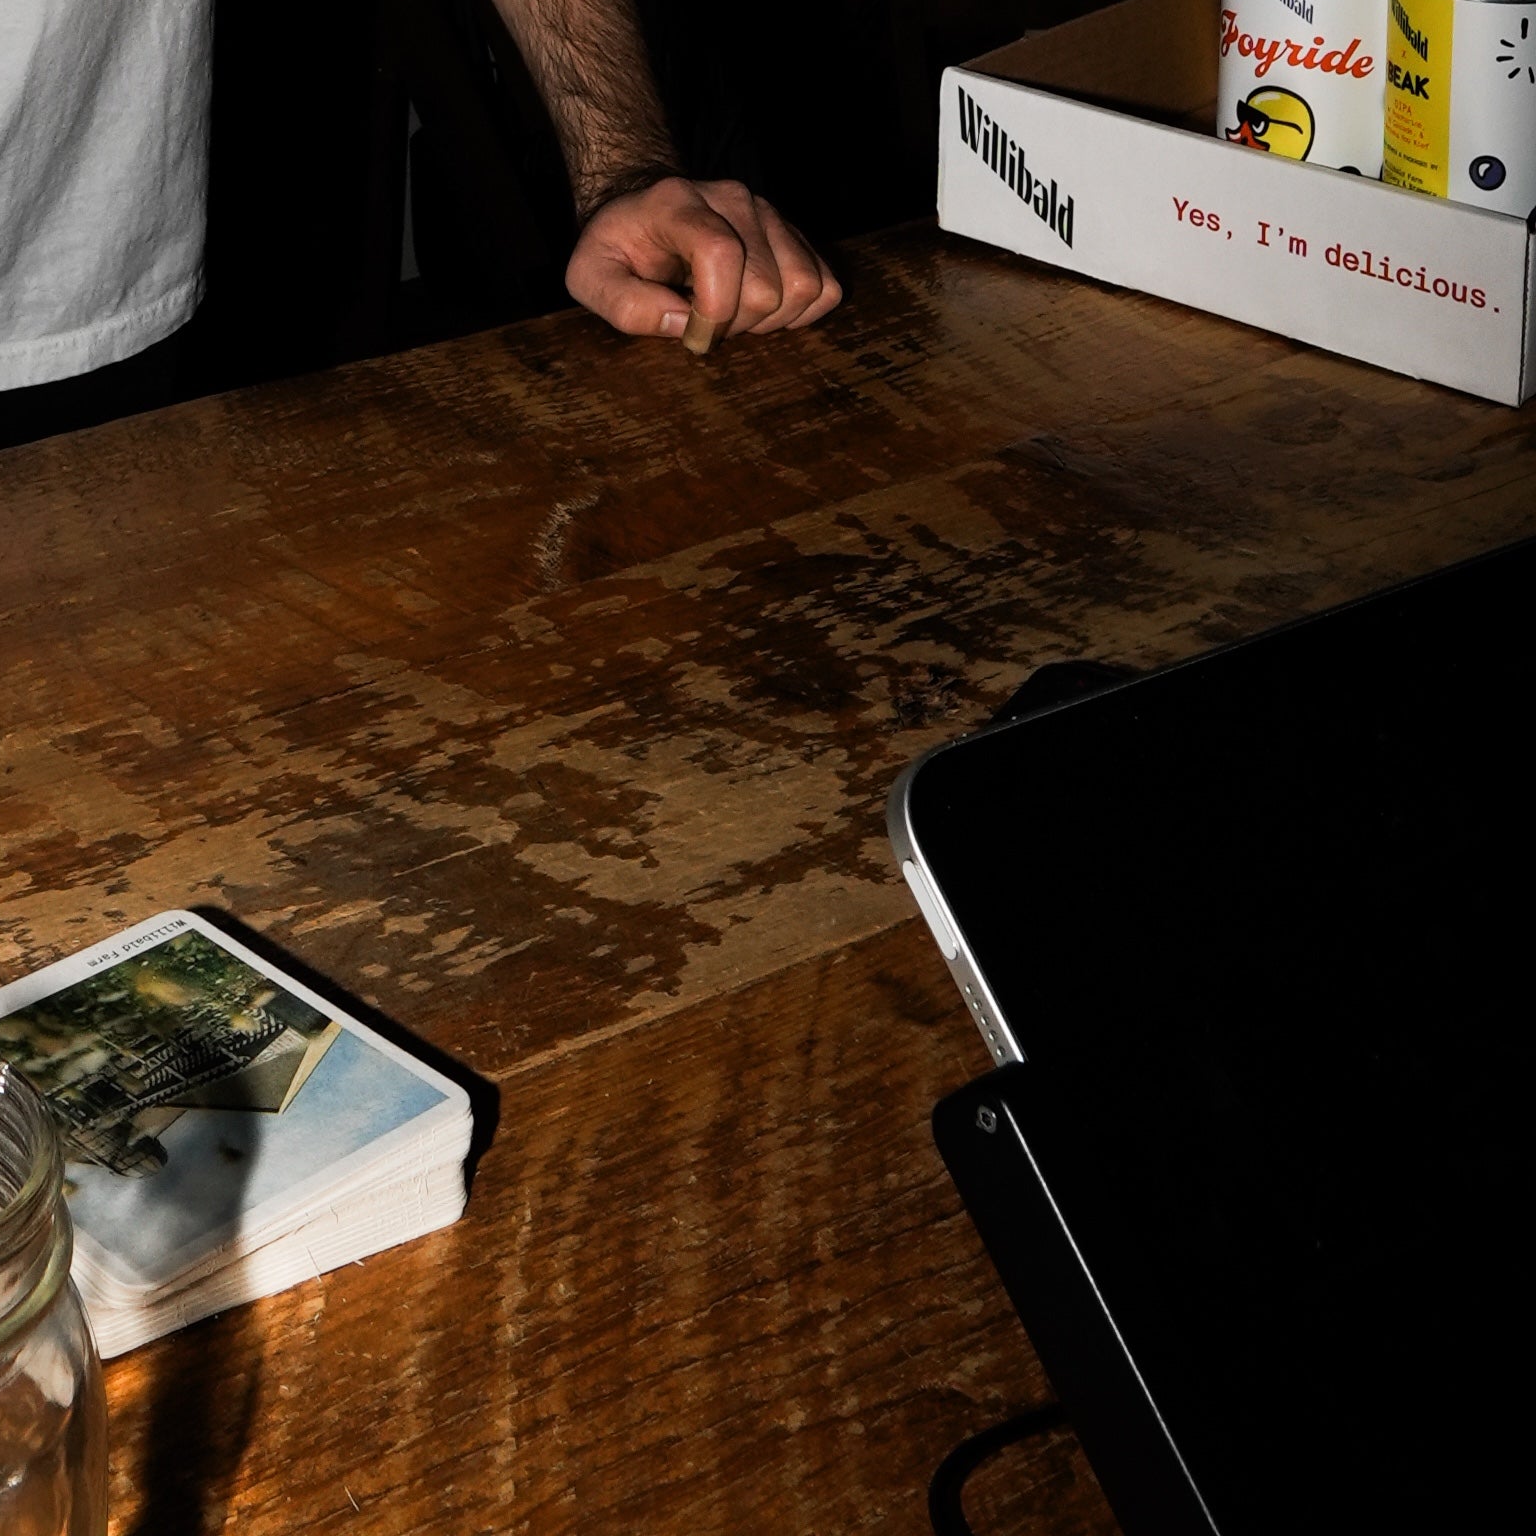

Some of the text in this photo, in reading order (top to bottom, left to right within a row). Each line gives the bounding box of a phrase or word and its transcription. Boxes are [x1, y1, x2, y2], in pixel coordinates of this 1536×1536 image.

[1221, 9, 1375, 78] Joyride
[1387, 59, 1430, 100] BEAK
[1394, 98, 1413, 117] DIPA
[957, 85, 1075, 250] Willibald
[1171, 197, 1503, 314] Yes, I'm delicious.
[86, 918, 188, 968] Willibald Farm
